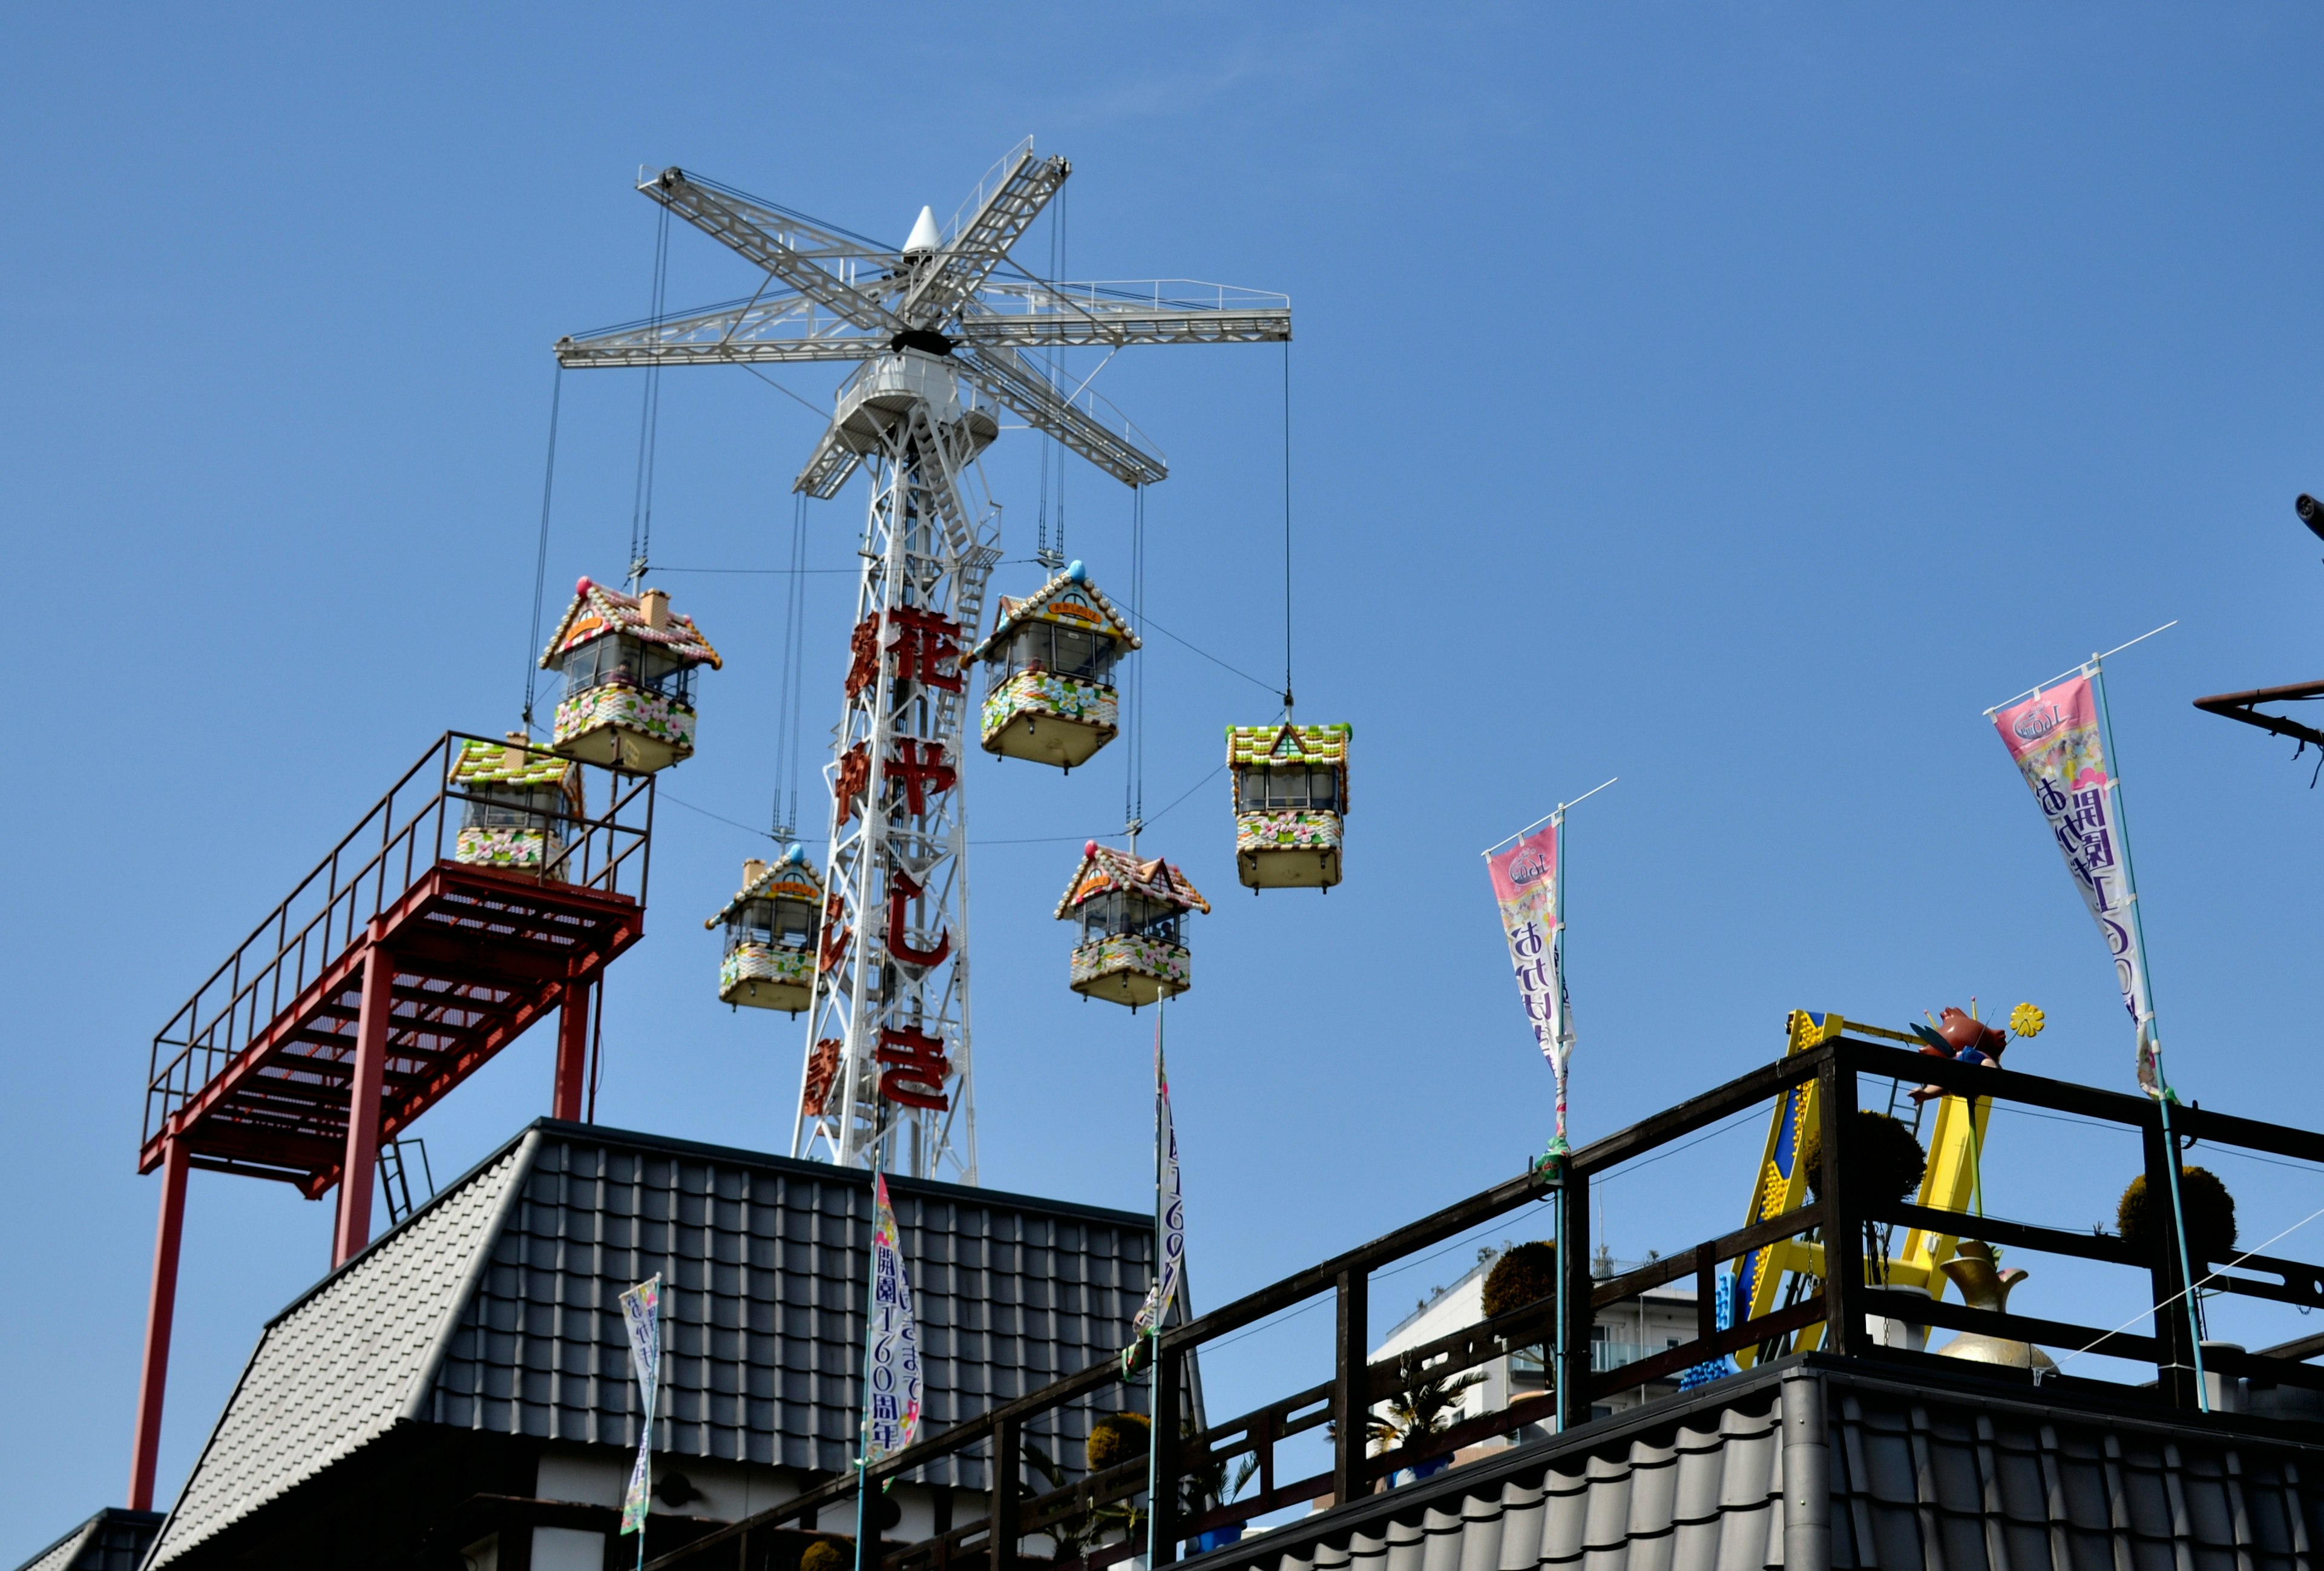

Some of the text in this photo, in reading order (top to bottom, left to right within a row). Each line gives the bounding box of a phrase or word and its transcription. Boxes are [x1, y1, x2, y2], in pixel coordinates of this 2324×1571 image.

[878, 606, 962, 1112] 花やしき
[872, 1246, 898, 1451] 開園160周年
